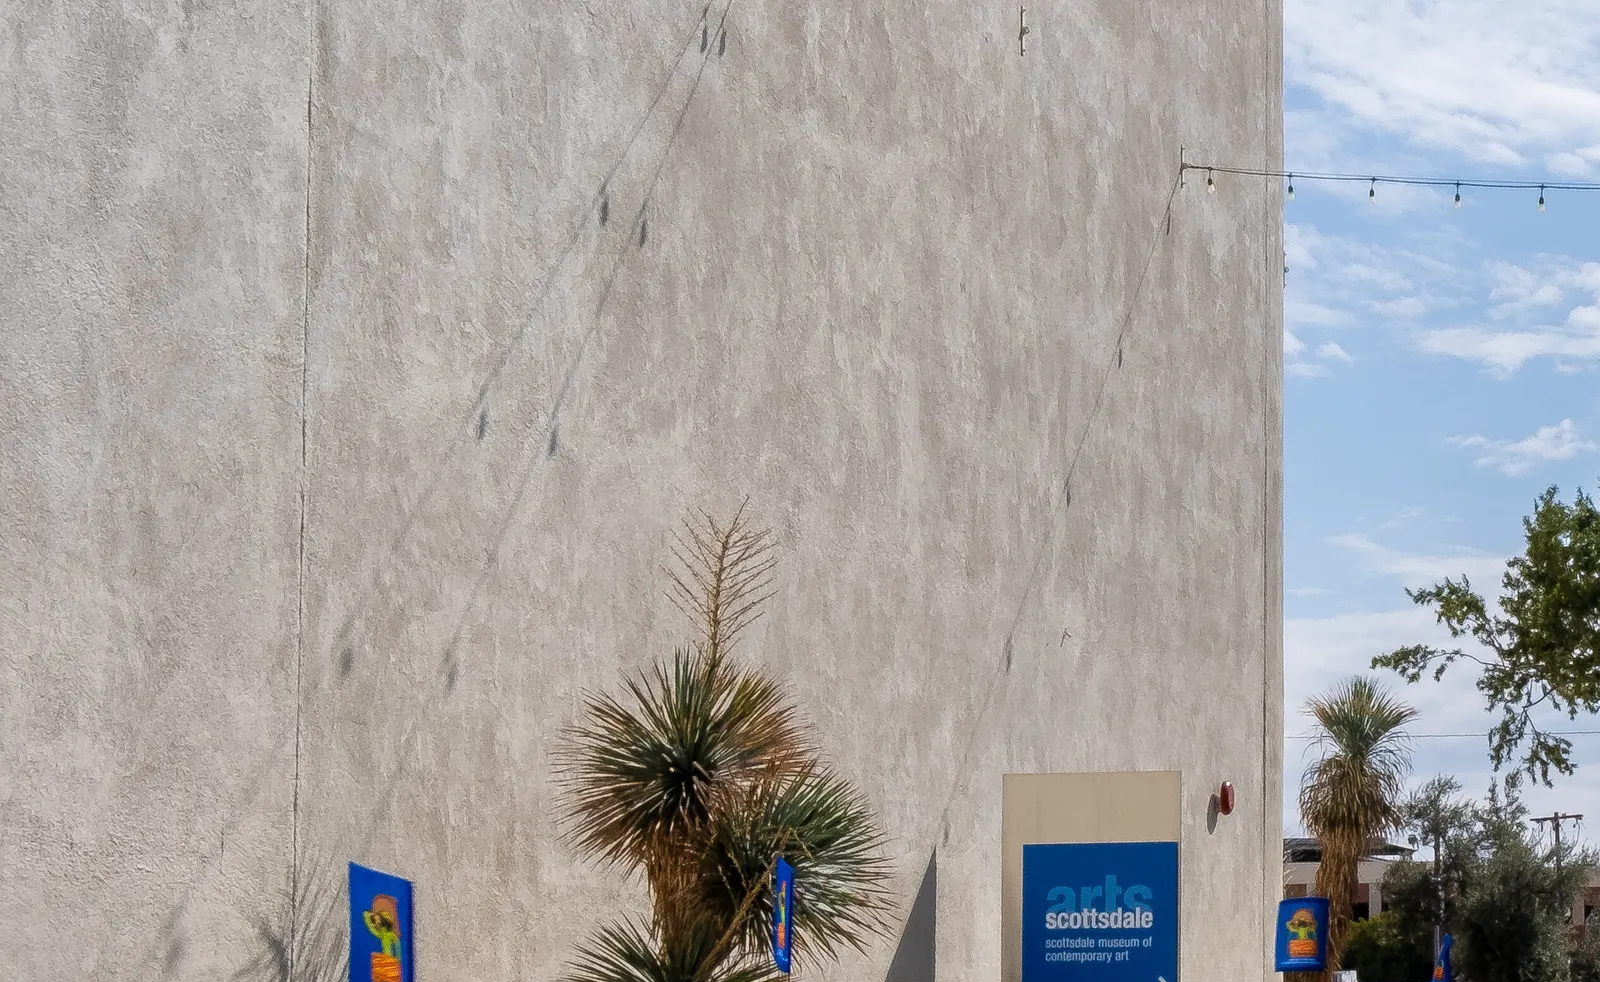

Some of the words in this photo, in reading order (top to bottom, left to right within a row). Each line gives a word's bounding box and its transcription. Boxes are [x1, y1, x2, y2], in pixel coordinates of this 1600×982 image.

[1046, 874, 1153, 913] arts
[1045, 907, 1153, 929] scottsdale
[1045, 937, 1095, 948] scottsdale
[1098, 938, 1140, 948] museum
[1142, 936, 1152, 947] of
[1045, 951, 1112, 963] contemporary
[1115, 950, 1129, 961] art
